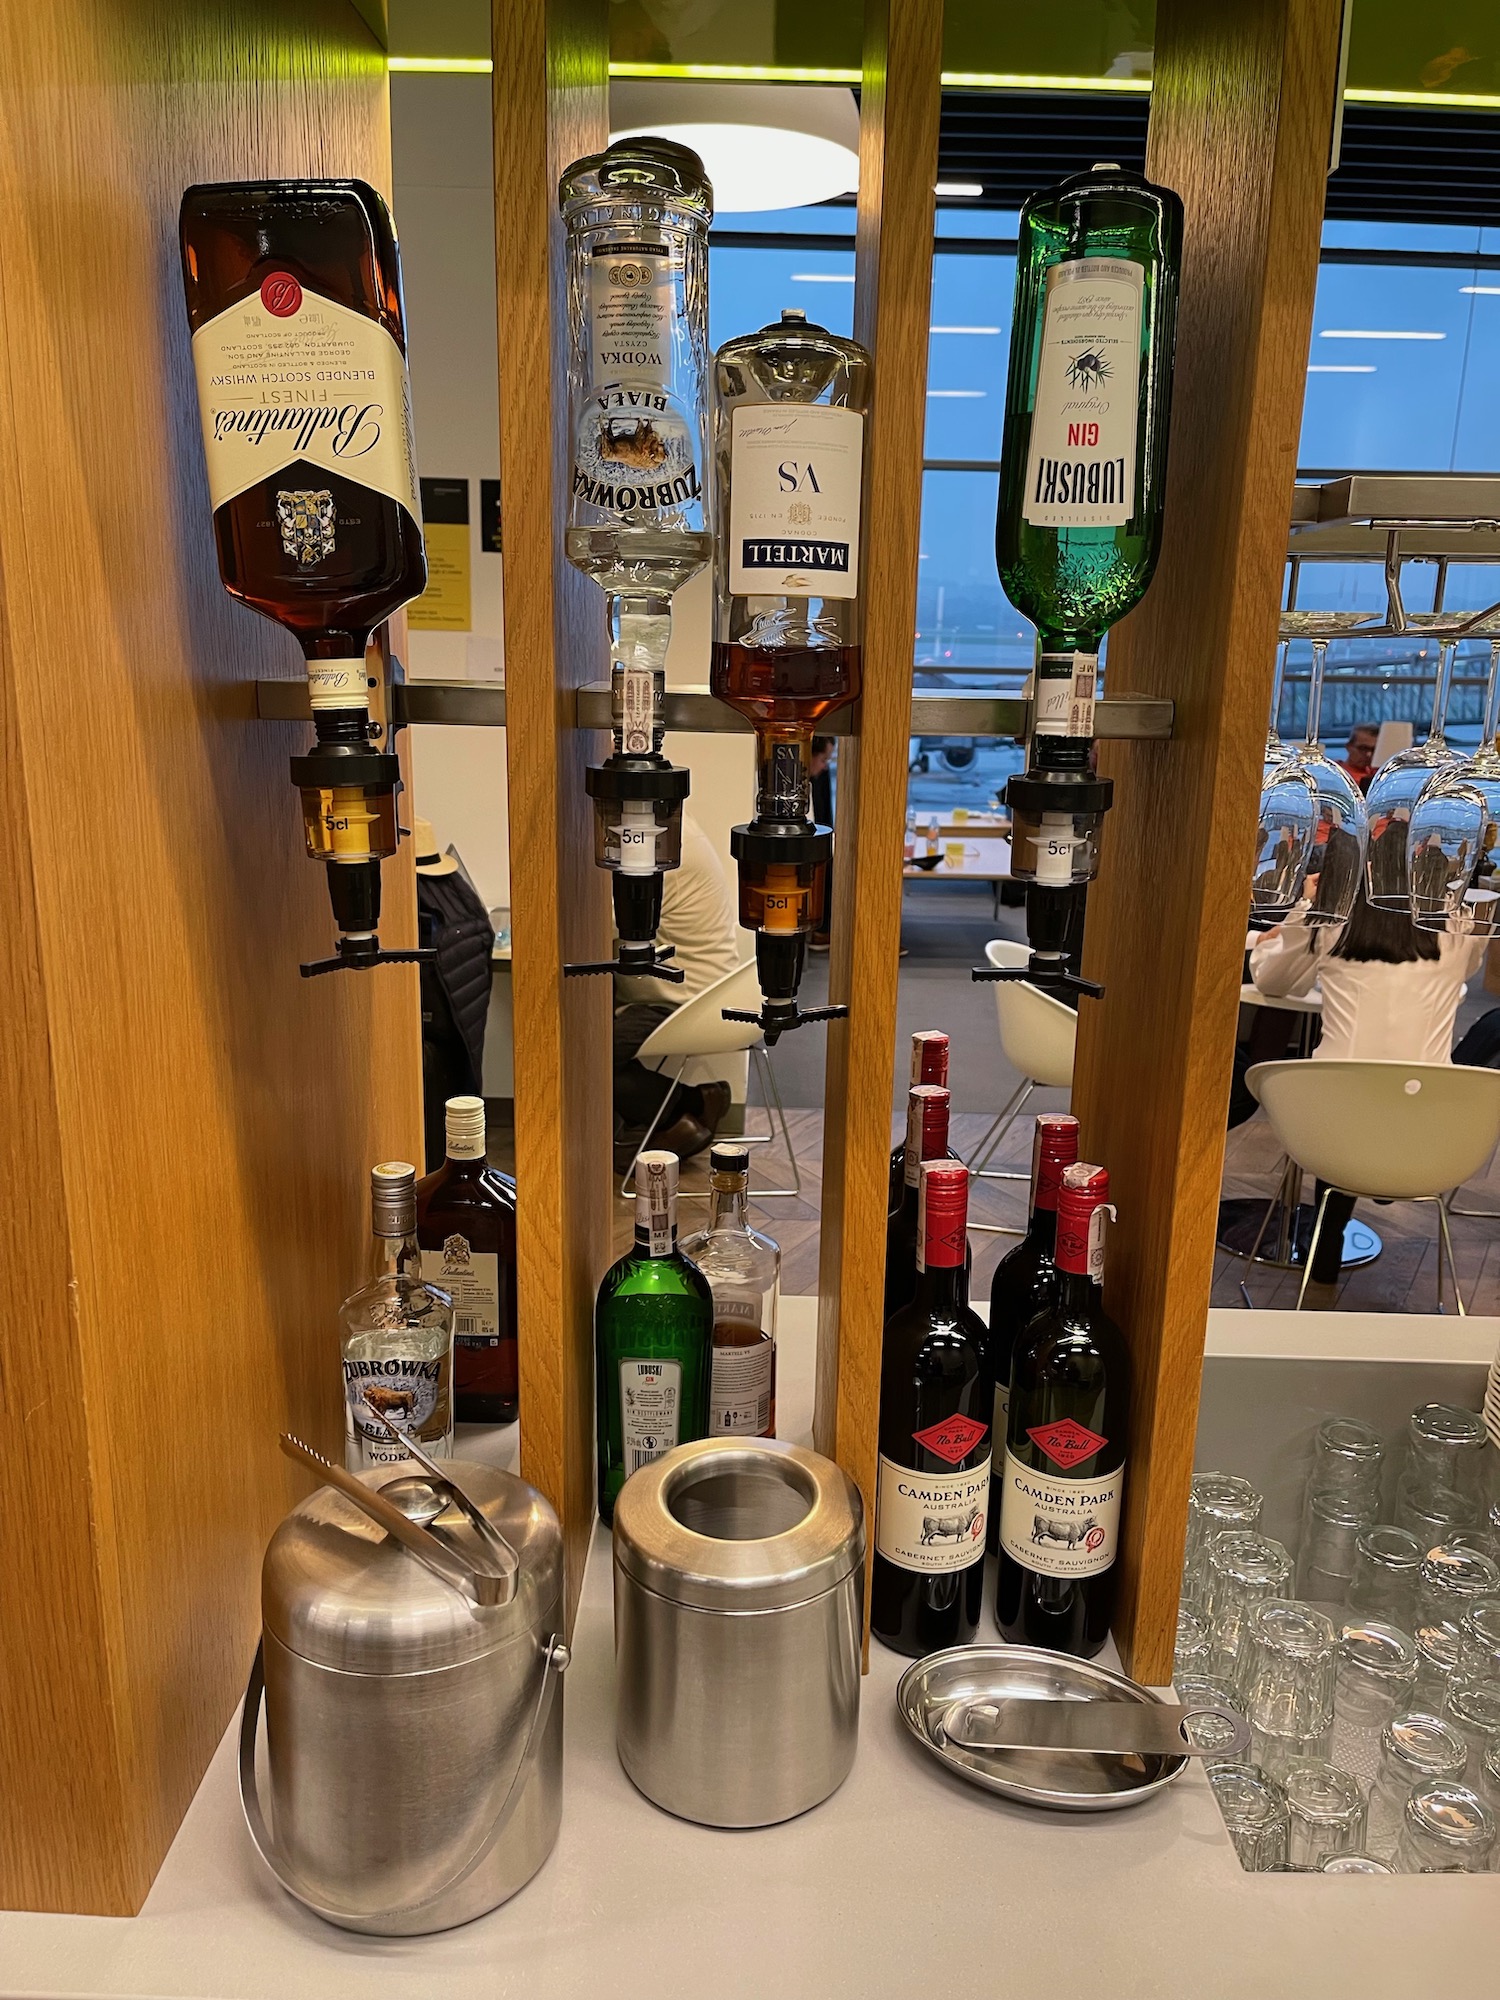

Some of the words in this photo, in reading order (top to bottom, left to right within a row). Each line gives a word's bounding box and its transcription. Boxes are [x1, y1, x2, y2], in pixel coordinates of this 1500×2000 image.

[600, 352, 662, 367] WÓDKA
[210, 374, 258, 386] WHISKY
[261, 372, 310, 383] SCOTCH
[316, 370, 374, 380] BLENDED
[259, 390, 327, 404] FINEST
[598, 391, 667, 412] BIAŁA
[1060, 396, 1110, 415] Original
[213, 404, 383, 458] Ballantine's
[1067, 423, 1099, 447] GIN
[778, 461, 822, 494] VS
[1034, 458, 1124, 504] LUBUSKI
[572, 463, 702, 512] ŻUBRÓWKA
[748, 545, 844, 566] MARTELL
[777, 746, 794, 760] VS
[326, 816, 348, 830] 5cl
[622, 829, 644, 843] 5cl
[1048, 840, 1070, 855] 5cl
[766, 895, 788, 909] 5cl
[638, 1364, 662, 1376] LUBUSKI
[363, 1423, 416, 1437] BIAA
[936, 1434, 951, 1445] No
[953, 1430, 974, 1444] Bull
[1046, 1435, 1061, 1447] No
[1064, 1437, 1090, 1450] Bull
[898, 1484, 962, 1501] CAMDEN
[1015, 1478, 1075, 1506] CAMDEN
[1079, 1489, 1115, 1506] PARK
[923, 1498, 977, 1510] AUSTRALIA
[1034, 1502, 1093, 1515] AUSTRALIA
[895, 1547, 946, 1561] CABERNET
[1010, 1539, 1055, 1564] CABERNET
[1059, 1552, 1110, 1566] SAUVIGNON
[945, 1555, 973, 1566] AUSTRALIA
[1031, 1560, 1051, 1568] SOUTH
